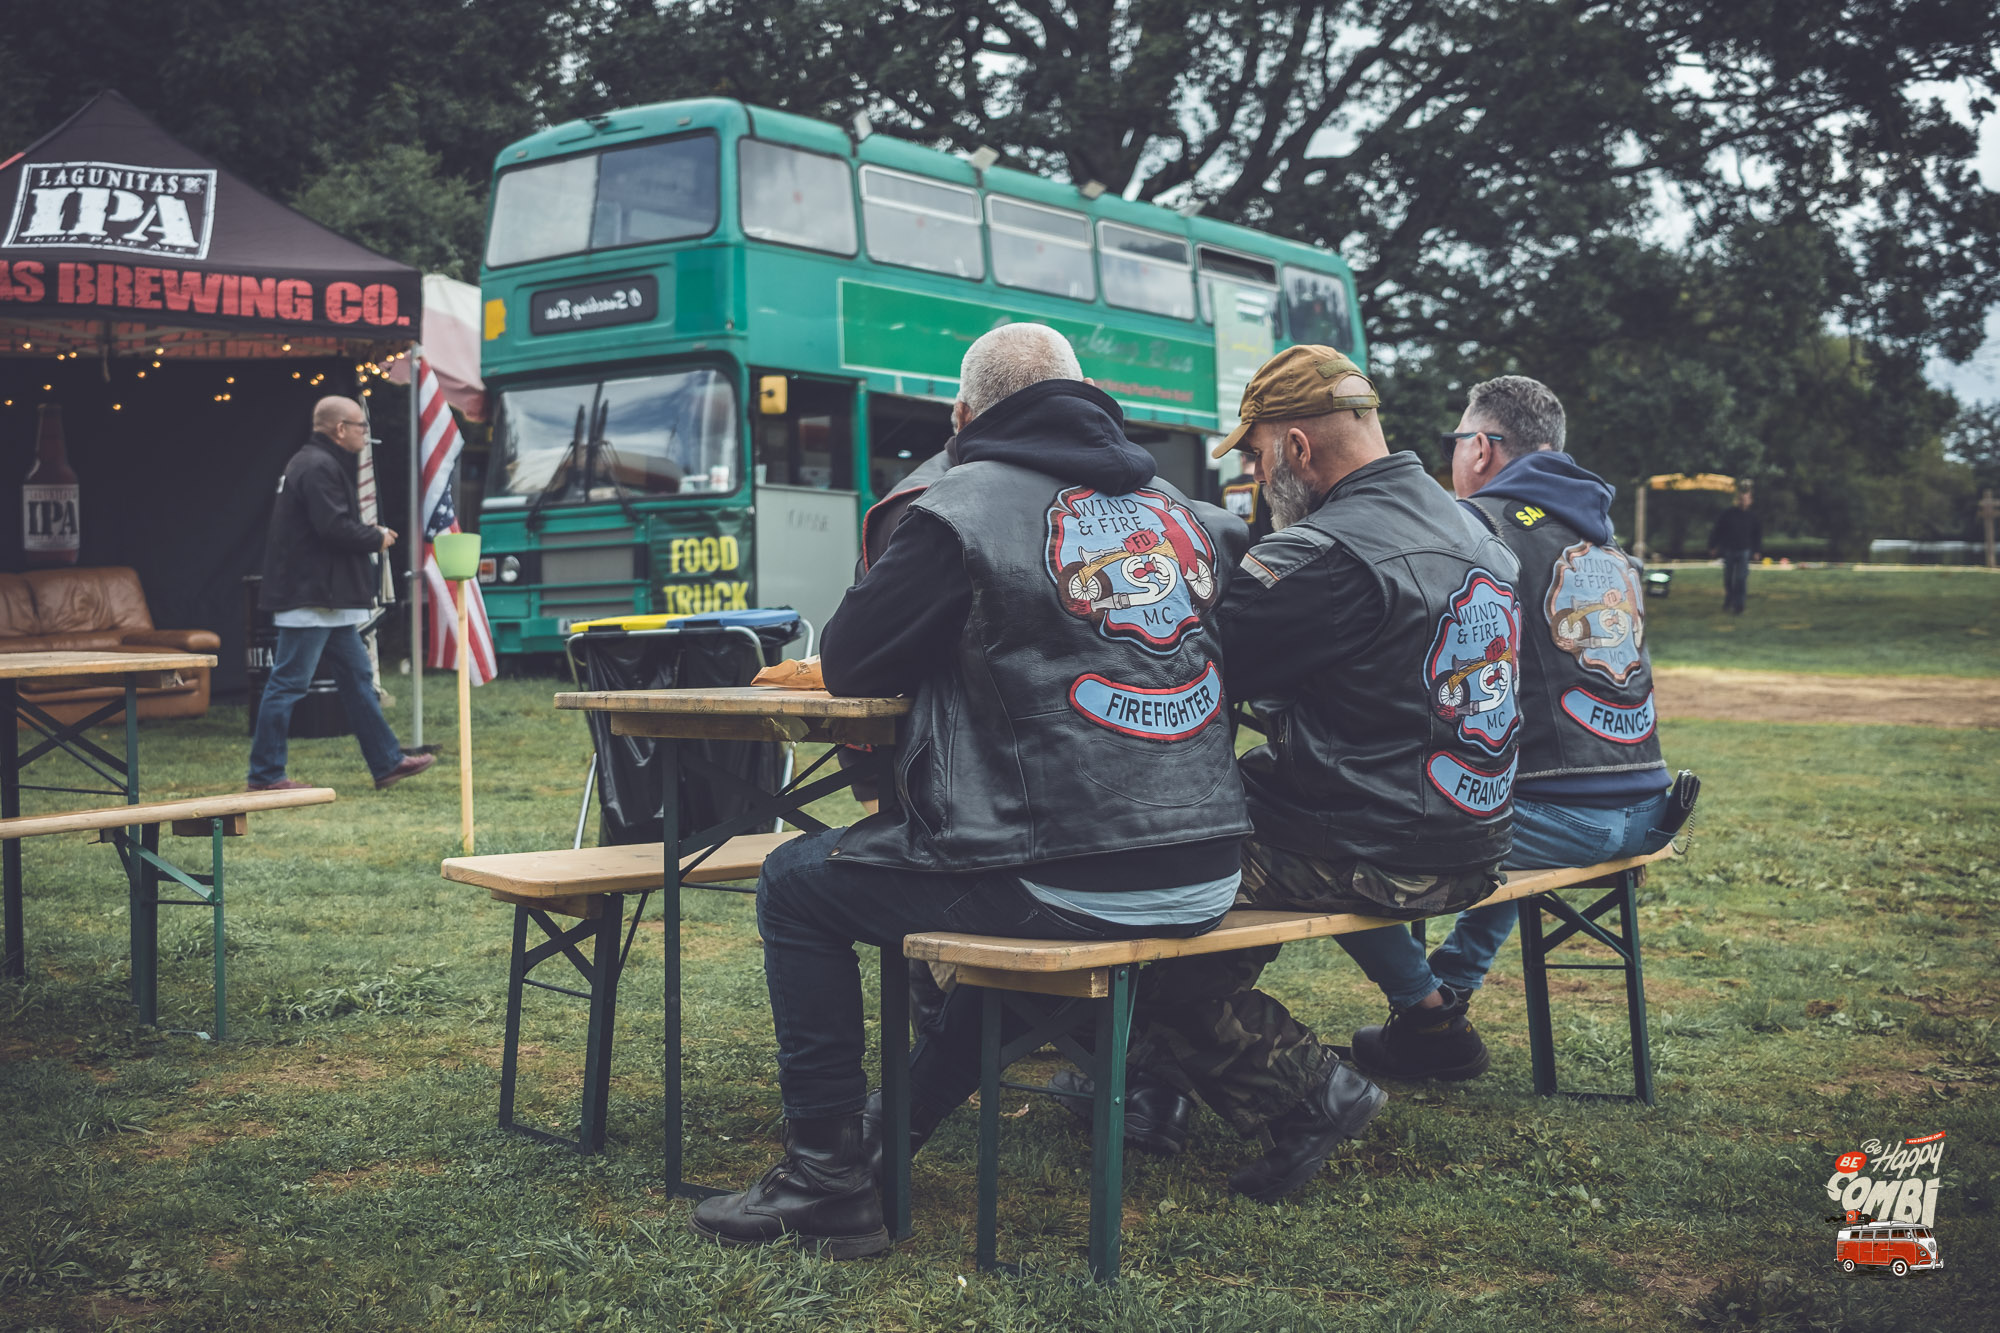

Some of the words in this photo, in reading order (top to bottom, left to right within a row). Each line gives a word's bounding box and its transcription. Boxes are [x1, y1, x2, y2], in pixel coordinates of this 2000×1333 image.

[39, 167, 180, 194] LAGUNITAS
[20, 187, 200, 248] IPA
[58, 262, 314, 321] BREWING
[325, 281, 411, 326] CO.
[28, 500, 79, 536] IPA
[1073, 499, 1138, 517] WIND
[1078, 520, 1093, 536] &
[1098, 516, 1145, 534] FIRE
[1132, 533, 1151, 549] FD
[669, 535, 739, 574] FOOD
[1573, 558, 1614, 575] WIND
[1574, 574, 1585, 588] &
[1589, 574, 1615, 590] FIRE
[663, 581, 749, 615] TRUCK
[1143, 606, 1174, 626] MC
[1459, 601, 1498, 625] WIND
[1457, 628, 1468, 645] &
[1472, 621, 1500, 643] FIRE
[1491, 641, 1502, 656] FD
[1609, 649, 1625, 664] MC
[1105, 684, 1215, 728] FIREFIGHTER
[1486, 711, 1506, 730] MC
[1589, 705, 1651, 734] FRANCE
[1454, 769, 1511, 806] FRANCE
